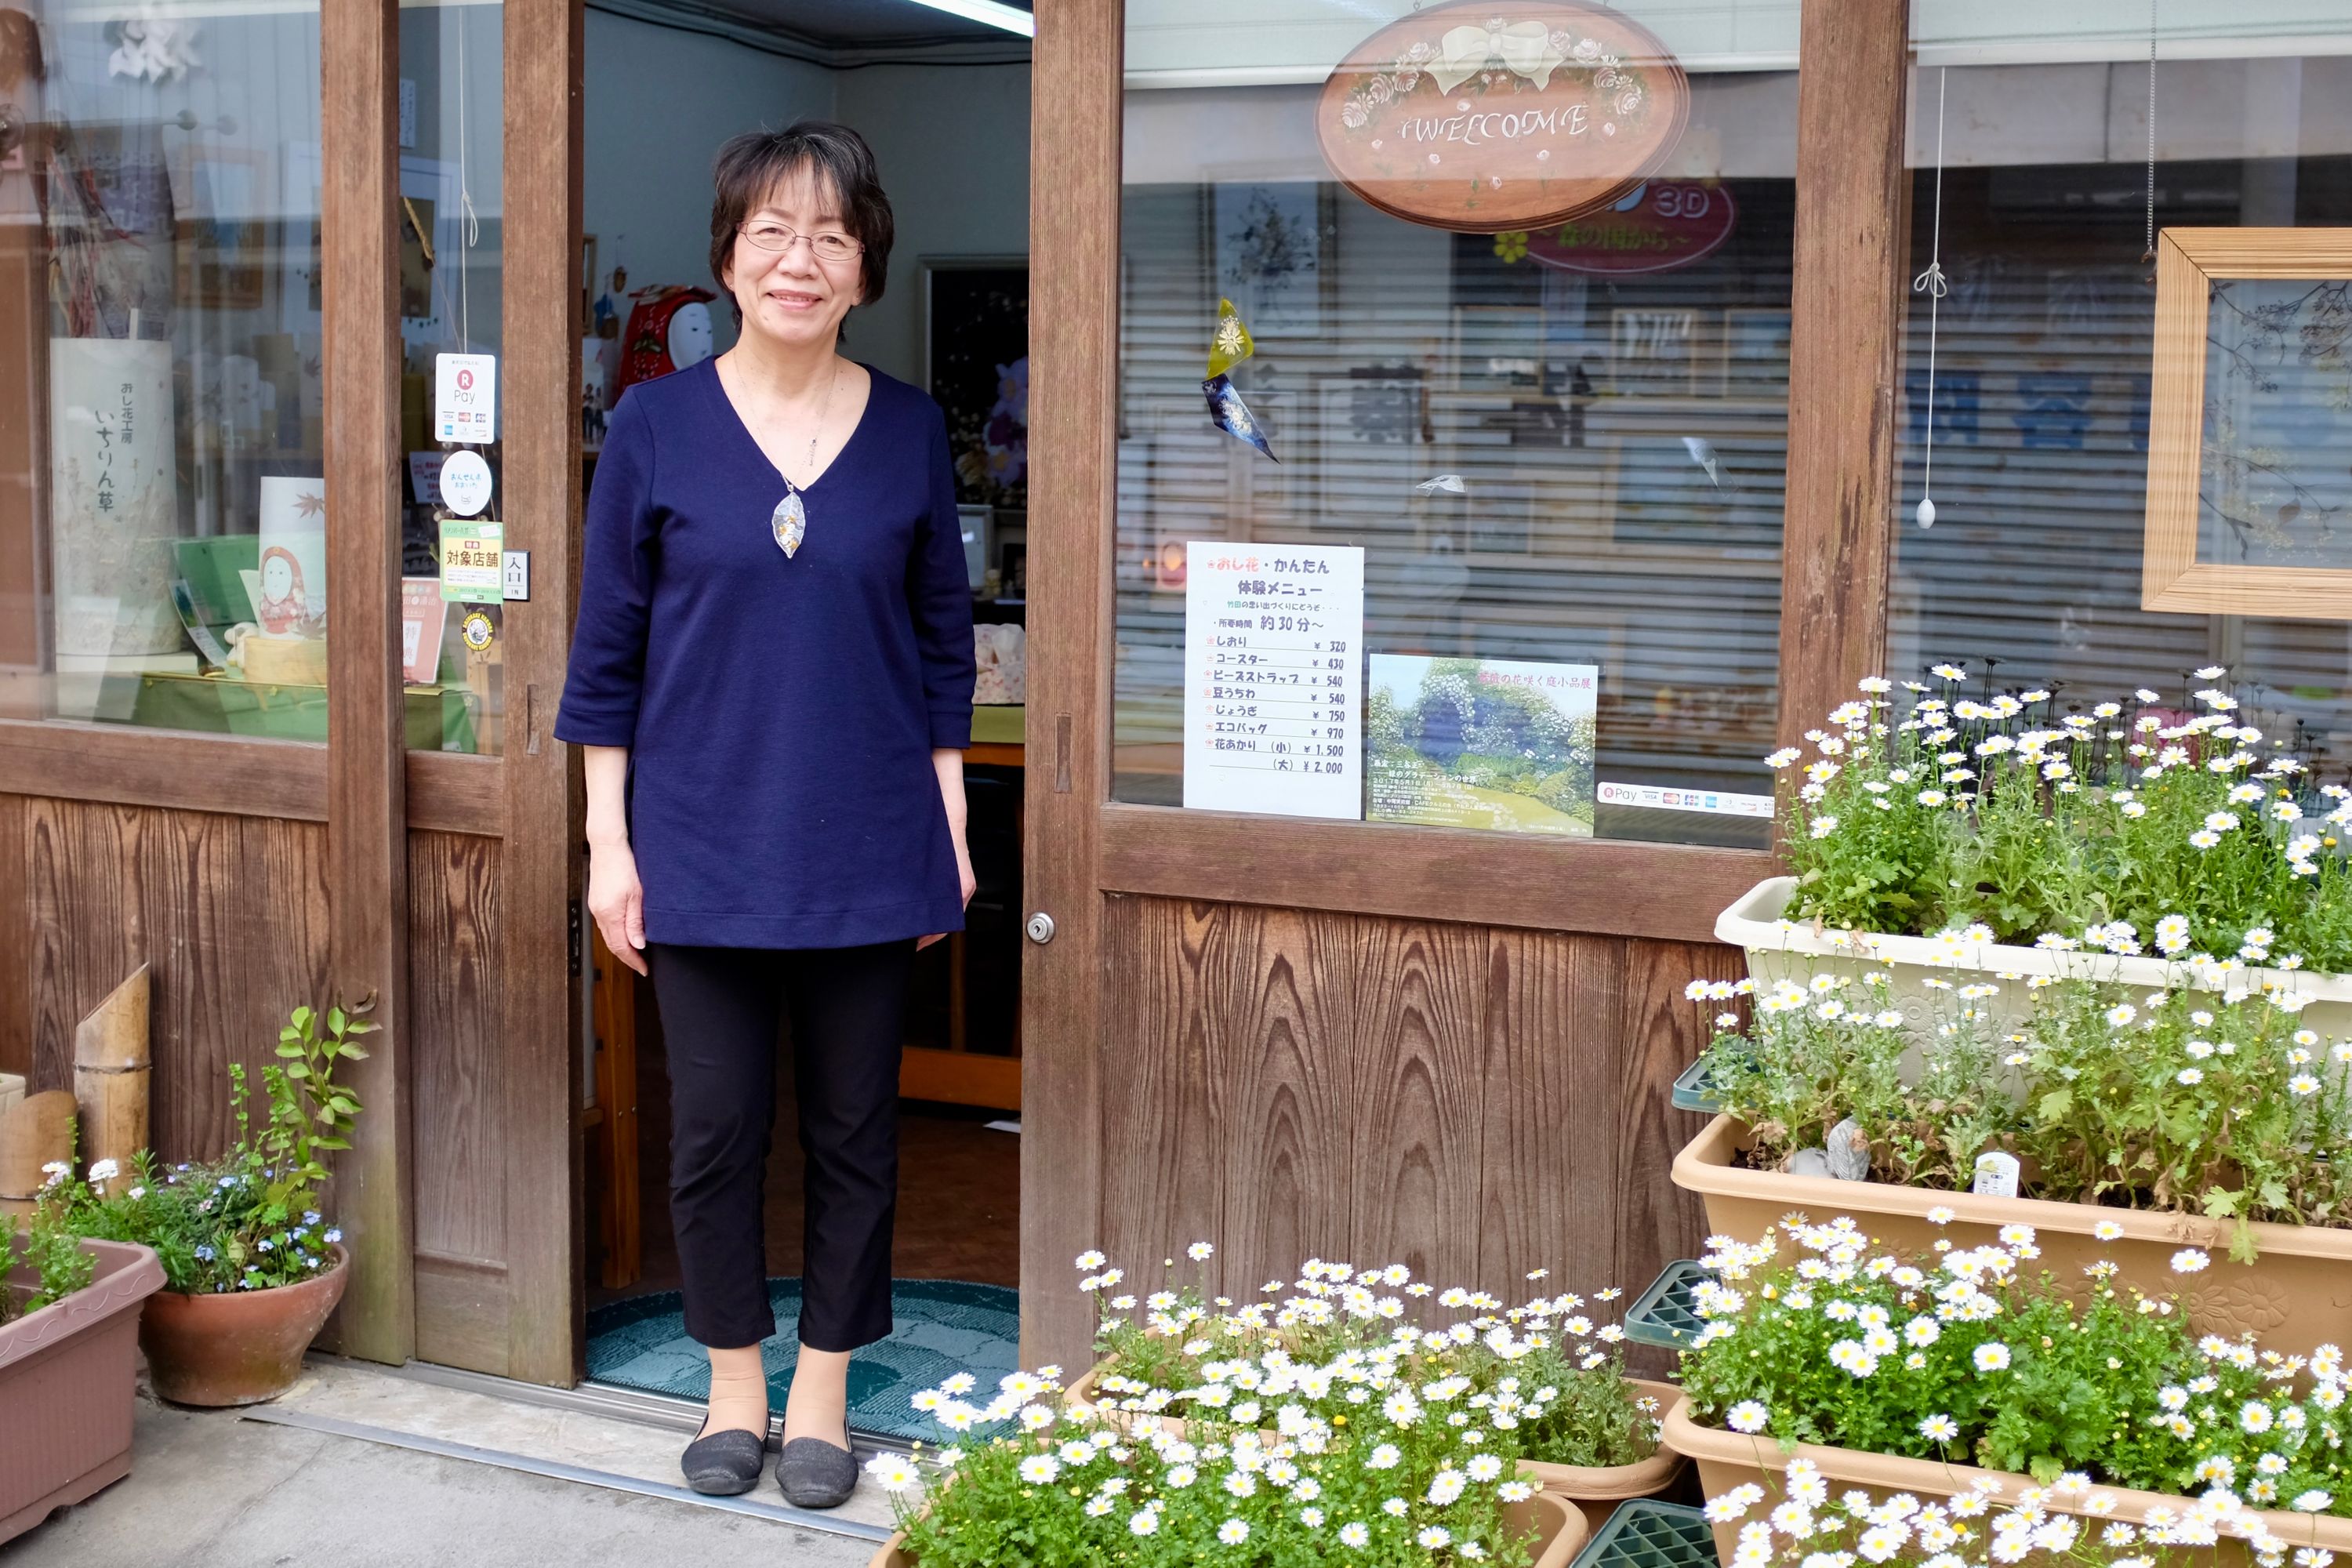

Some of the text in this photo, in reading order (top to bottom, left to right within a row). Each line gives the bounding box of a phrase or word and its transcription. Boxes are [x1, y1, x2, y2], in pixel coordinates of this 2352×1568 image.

[1399, 103, 1588, 144] WELCOME
[1654, 186, 1709, 218] 3D
[454, 390, 475, 405] Pay
[121, 383, 133, 444] おし花工房
[95, 410, 115, 513] いちりん草
[446, 550, 499, 568] 対象店舗
[508, 557, 521, 583] 入口
[1238, 580, 1323, 596] 体験メニュー
[1217, 636, 1247, 648] しおり
[1330, 641, 1346, 652] 320
[1217, 654, 1269, 664] コースター
[1328, 659, 1344, 670] 430
[1214, 670, 1299, 684] ビーズストラップ
[1327, 675, 1343, 687] 540
[1213, 687, 1255, 699] 豆うちわ
[1329, 693, 1345, 704] 540
[1215, 704, 1258, 717] じょうぎ
[1329, 710, 1345, 721] 750
[1327, 728, 1344, 739] 970
[1215, 738, 1255, 751] 花あかり
[1615, 788, 1637, 801] Pay
